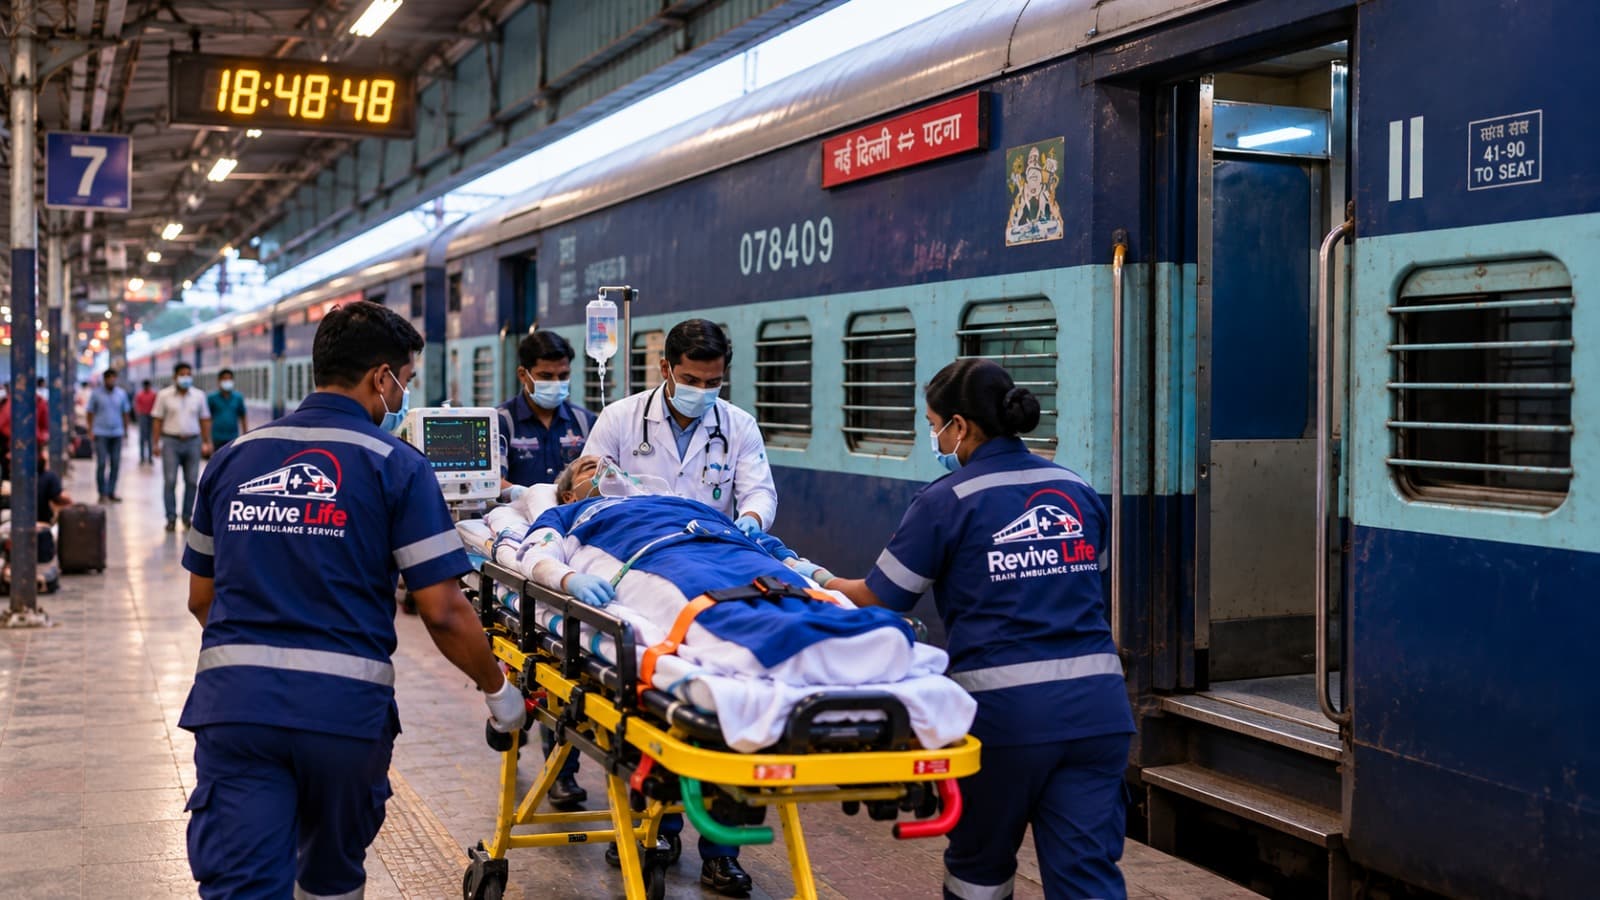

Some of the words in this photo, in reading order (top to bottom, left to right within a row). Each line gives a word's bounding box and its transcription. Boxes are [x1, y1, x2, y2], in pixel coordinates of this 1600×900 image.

[217, 69, 396, 124] 18:48:48
[833, 139, 852, 175] नई
[856, 127, 892, 167] दिल्ली
[922, 113, 962, 147] पटना
[1483, 140, 1525, 162] 41-90
[71, 145, 108, 197] 7
[1474, 166, 1494, 183] TO
[1499, 160, 1535, 180] SEAT
[740, 216, 833, 276] 078409
[228, 500, 300, 523] Revive
[303, 502, 348, 527] Life
[227, 524, 249, 532] TRAIN
[252, 524, 304, 534] AMBULANCE
[307, 527, 346, 538] SERVICE
[987, 545, 1059, 573] Revive
[1061, 539, 1096, 563] Life
[990, 572, 1017, 582] TRAIN
[1020, 565, 1067, 579] AMBULANCE
